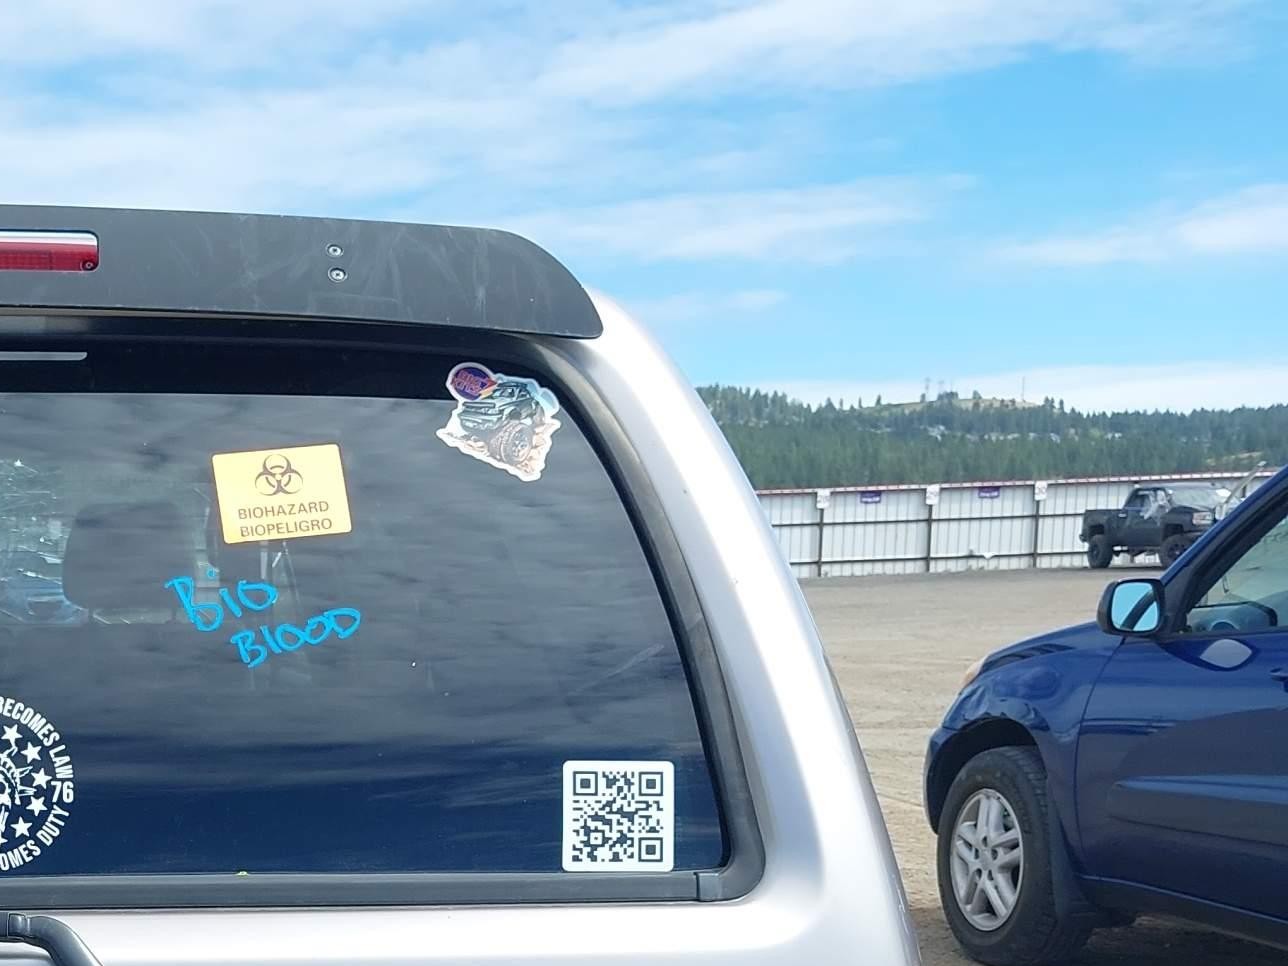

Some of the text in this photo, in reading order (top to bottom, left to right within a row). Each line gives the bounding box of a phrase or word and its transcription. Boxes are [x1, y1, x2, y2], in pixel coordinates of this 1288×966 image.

[238, 501, 329, 520] BIOHAZARD
[240, 518, 333, 537] BIOPELIGRO
[49, 744, 74, 779] LAW
[51, 781, 75, 803] 76
[36, 804, 70, 847] DUTY
